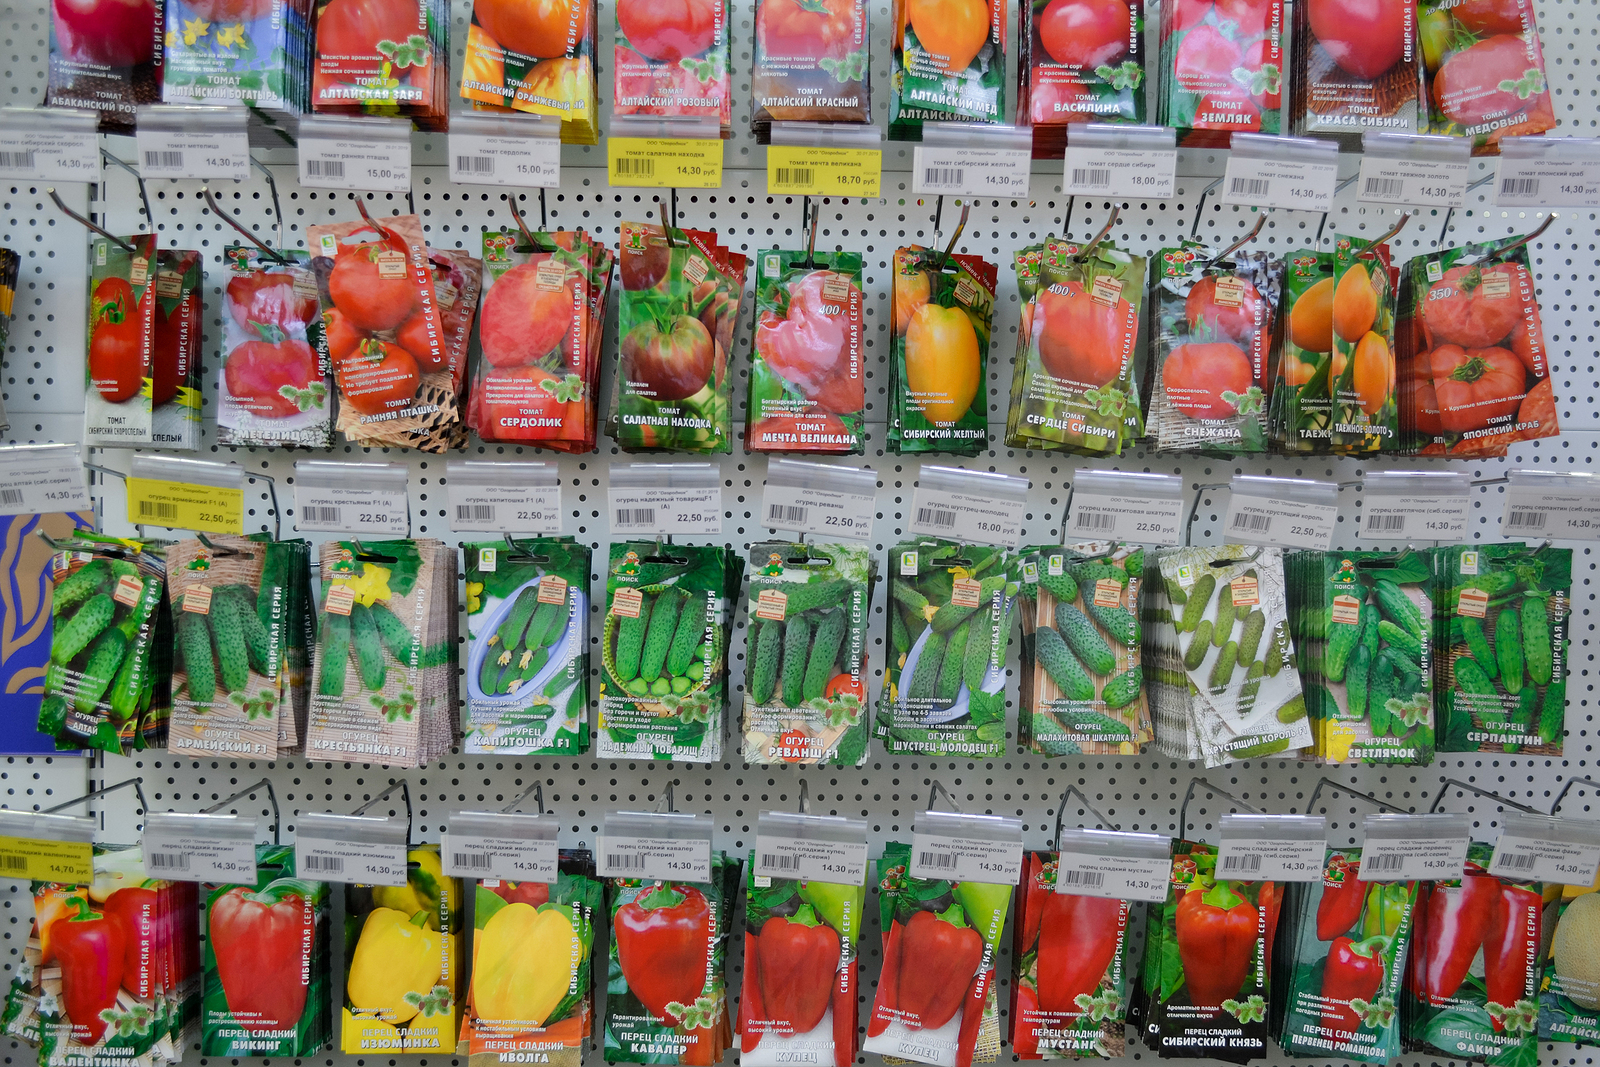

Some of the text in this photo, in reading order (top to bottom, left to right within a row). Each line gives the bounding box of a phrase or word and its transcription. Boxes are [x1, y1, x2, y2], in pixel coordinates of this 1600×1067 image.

[207, 76, 241, 85] ТОМАТ
[355, 77, 388, 86] ТОМАТ
[170, 86, 278, 101] АЛТАЙСКИЙ БОГАТЫРЬ
[320, 89, 423, 100] АЛТАЙСКАЯ ЗАРЯ
[464, 80, 571, 112] АЛТАЙСКИЙ ОРАНЖЕВЫЙ
[52, 97, 117, 112] АБАКАНСКИЙ
[621, 97, 720, 107] АЛТАЙСКИЙ РОЗОВЫЙ
[761, 97, 858, 108] АЛТАЙСКИЙ КРАСНЫЙ
[911, 90, 998, 115] АЛТАЙСКИЙ МЕД
[1054, 102, 1120, 113] ВАСИЛИНА
[1211, 100, 1242, 109] ТОМАТ
[1348, 105, 1380, 114] ТОМАТ
[1200, 112, 1252, 124] ЗЕМЛЯК
[1317, 116, 1408, 128] КРАСА СИБИРИ
[1465, 114, 1528, 136] МЕДОВЫЙ
[206, 158, 246, 168] 14,30 руб.
[367, 169, 407, 180] 15,00 руб.
[677, 165, 717, 176] 14,30 руб.
[837, 175, 877, 186] 18,70 руб.
[985, 175, 1025, 186] 14,30 руб.
[1560, 185, 1584, 194] 14,30
[1048, 284, 1068, 296] 400
[1428, 287, 1452, 301] 350
[819, 304, 840, 315] 400
[385, 398, 412, 408] ТОМАТ
[360, 404, 439, 424] РАННЯЯ ПТАШКА
[519, 408, 544, 416] ТОМАТ
[1062, 411, 1086, 421] ТОМАТ
[500, 417, 562, 428] СЕРДОЛИК
[623, 415, 712, 429] САЛАТНАЯ НАХОДКА
[1027, 414, 1116, 439] СЕРДЦЕ СИБИРИ
[88, 425, 146, 436] СИБИРСКИЙ СКОРОСПЕЛЫЙ
[904, 429, 985, 439] СИБИРСКИЙ ЖЕЛТЫЙ
[1184, 427, 1241, 438] СНЕЖАНА
[1335, 423, 1387, 434] ТАЕЖНОЕ ЗОЛОТО
[1463, 420, 1540, 440] ЯПОНСКИЙ КРАБ
[762, 433, 858, 444] МЕЧТА ВЕЛИКАНА
[360, 513, 404, 524] 22,50 руб.
[1291, 525, 1329, 538] 22,50 руб.
[703, 590, 715, 686] СИБИРСКАЯ СЕРИЯ
[73, 723, 98, 736] АЛТАЙ
[504, 727, 541, 736] ОГУРЕЦ
[1485, 722, 1525, 732] ОГУРЕЦ
[636, 732, 674, 742] ОГУРЕЦ
[785, 736, 824, 746] ОГУРЕЦ
[927, 731, 965, 741] ОГУРЕЦ
[1037, 733, 1130, 742] МАЛАХИТОВАЯ ШКАТУЛКА
[1466, 733, 1542, 745] СЕРПАНТИН
[177, 738, 267, 754] АРМЕЙСКИЙ F1
[474, 736, 570, 748] КАПИТОШКА F1
[893, 741, 999, 754] ШУСТРЕЦ-МОЛОДЕЦ F1
[1207, 729, 1296, 755] ХРУСТЯЩИЙ КОРОЛЬ
[1365, 737, 1399, 747] ОГУРЕЦ
[314, 740, 406, 756] КРЕСТЬЯНКА F1
[602, 741, 710, 756] НАДЕЖНЫЙ ТОВАРИЩ F1
[768, 747, 838, 759] РЕВАНШ F1
[1347, 748, 1415, 759] СВЕТЛЯЧОК
[366, 865, 389, 874] 14,30
[668, 861, 707, 872] 14,30 руб.
[302, 895, 312, 985] СИБИРСКАЯ СЕРИЯ
[219, 1029, 296, 1039] ПЕРЕЦ СЛАДКИЙ
[772, 1027, 794, 1035] урожай
[1032, 1029, 1104, 1038] ПЕРЕЦ СЛАДКИЙ
[1185, 1028, 1209, 1036] ПЕРЕЦ
[361, 1038, 440, 1049] ИЗЮМИНКА
[621, 1033, 698, 1043] ПЕРЕЦ СЛАДКИЙ
[1038, 1038, 1095, 1049] МУСТАНГ
[1162, 1037, 1262, 1048] СИБИРСКИЙ КНЯЗЬ
[232, 1040, 281, 1050] ВИКИНГ
[631, 1043, 687, 1055] КАВАЛЕР
[1292, 1035, 1386, 1058] ПЕРВЕНЕЦ РОМАНЦОВА
[1456, 1041, 1502, 1056] ФАКИР
[499, 1052, 549, 1063] ИВОЛГА
[776, 1052, 817, 1063] КУПЕЦ
